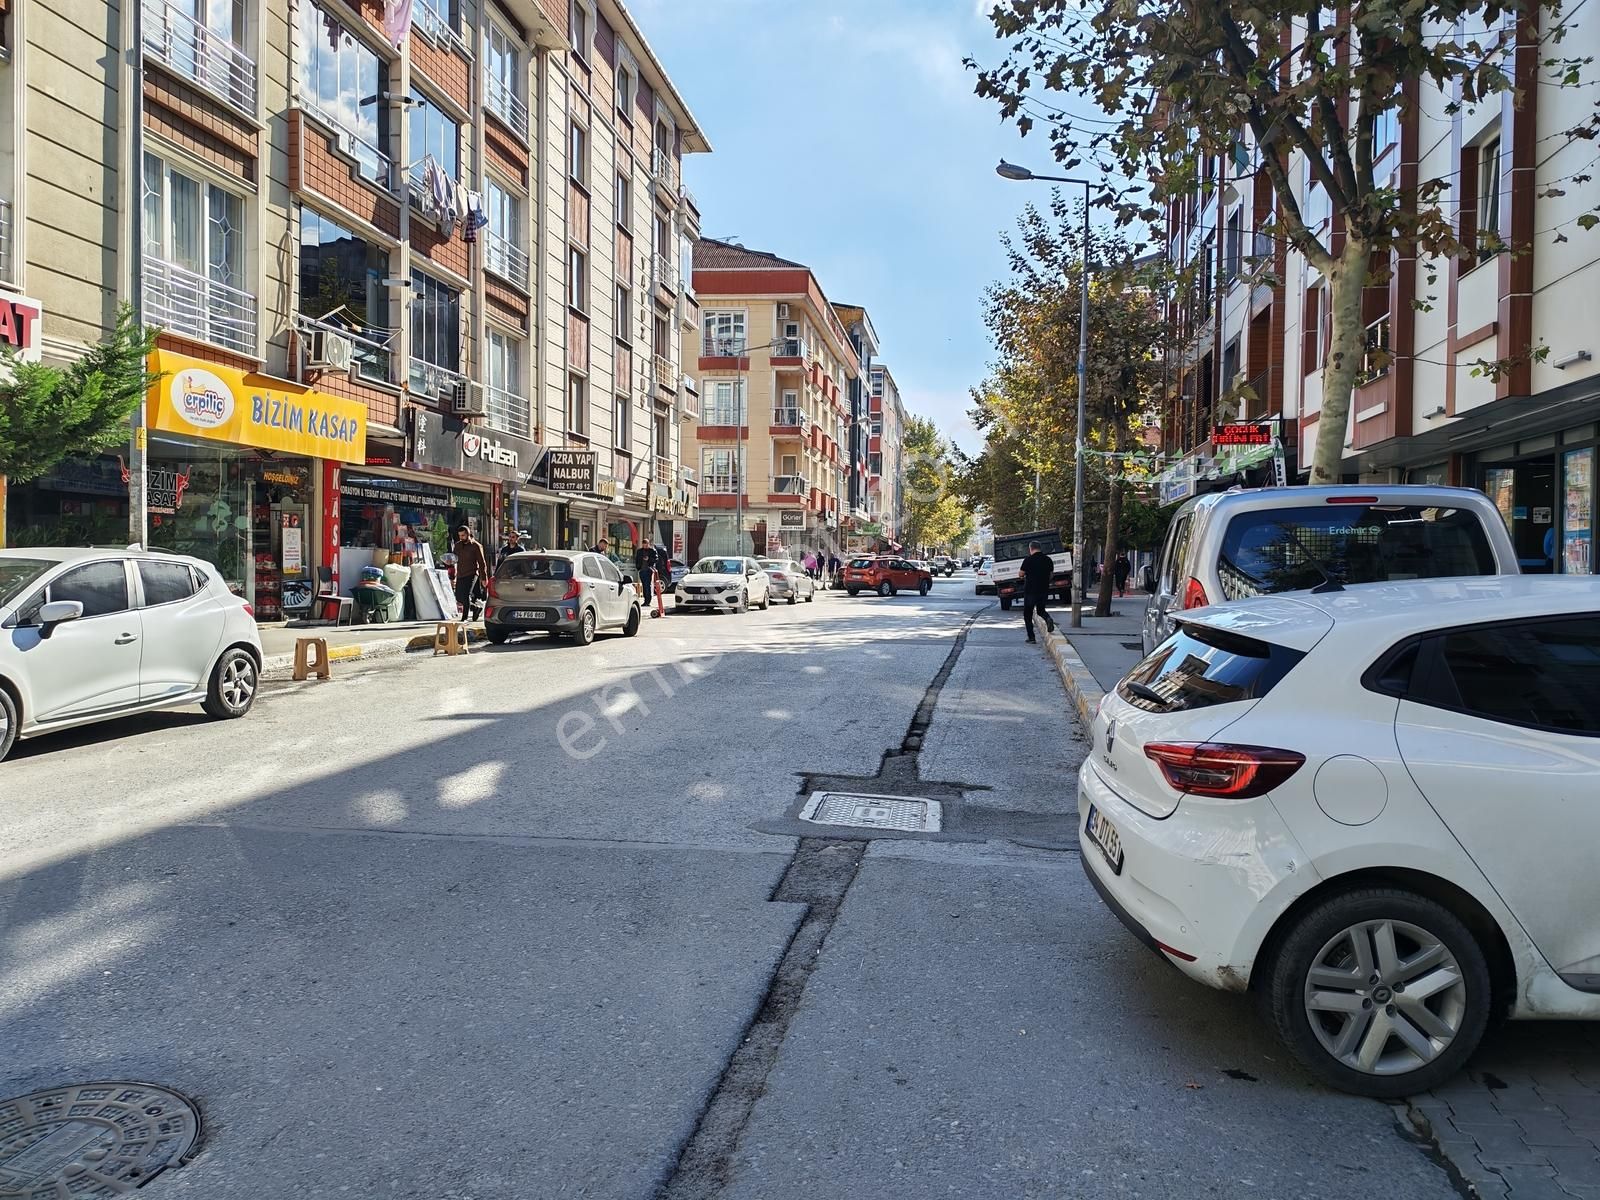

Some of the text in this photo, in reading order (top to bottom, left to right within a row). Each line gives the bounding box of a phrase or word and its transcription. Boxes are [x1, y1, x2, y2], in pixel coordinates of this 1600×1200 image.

[184, 391, 225, 417] erpiliç
[251, 391, 358, 443] BİZİM KASAP
[480, 437, 518, 468] Polisan
[551, 453, 595, 465] AZRA YAPI
[147, 466, 177, 491] İZİM
[553, 467, 591, 480] NALBUR
[552, 482, 565, 490] 0532
[584, 483, 591, 491] 12
[147, 491, 177, 506] ASAP
